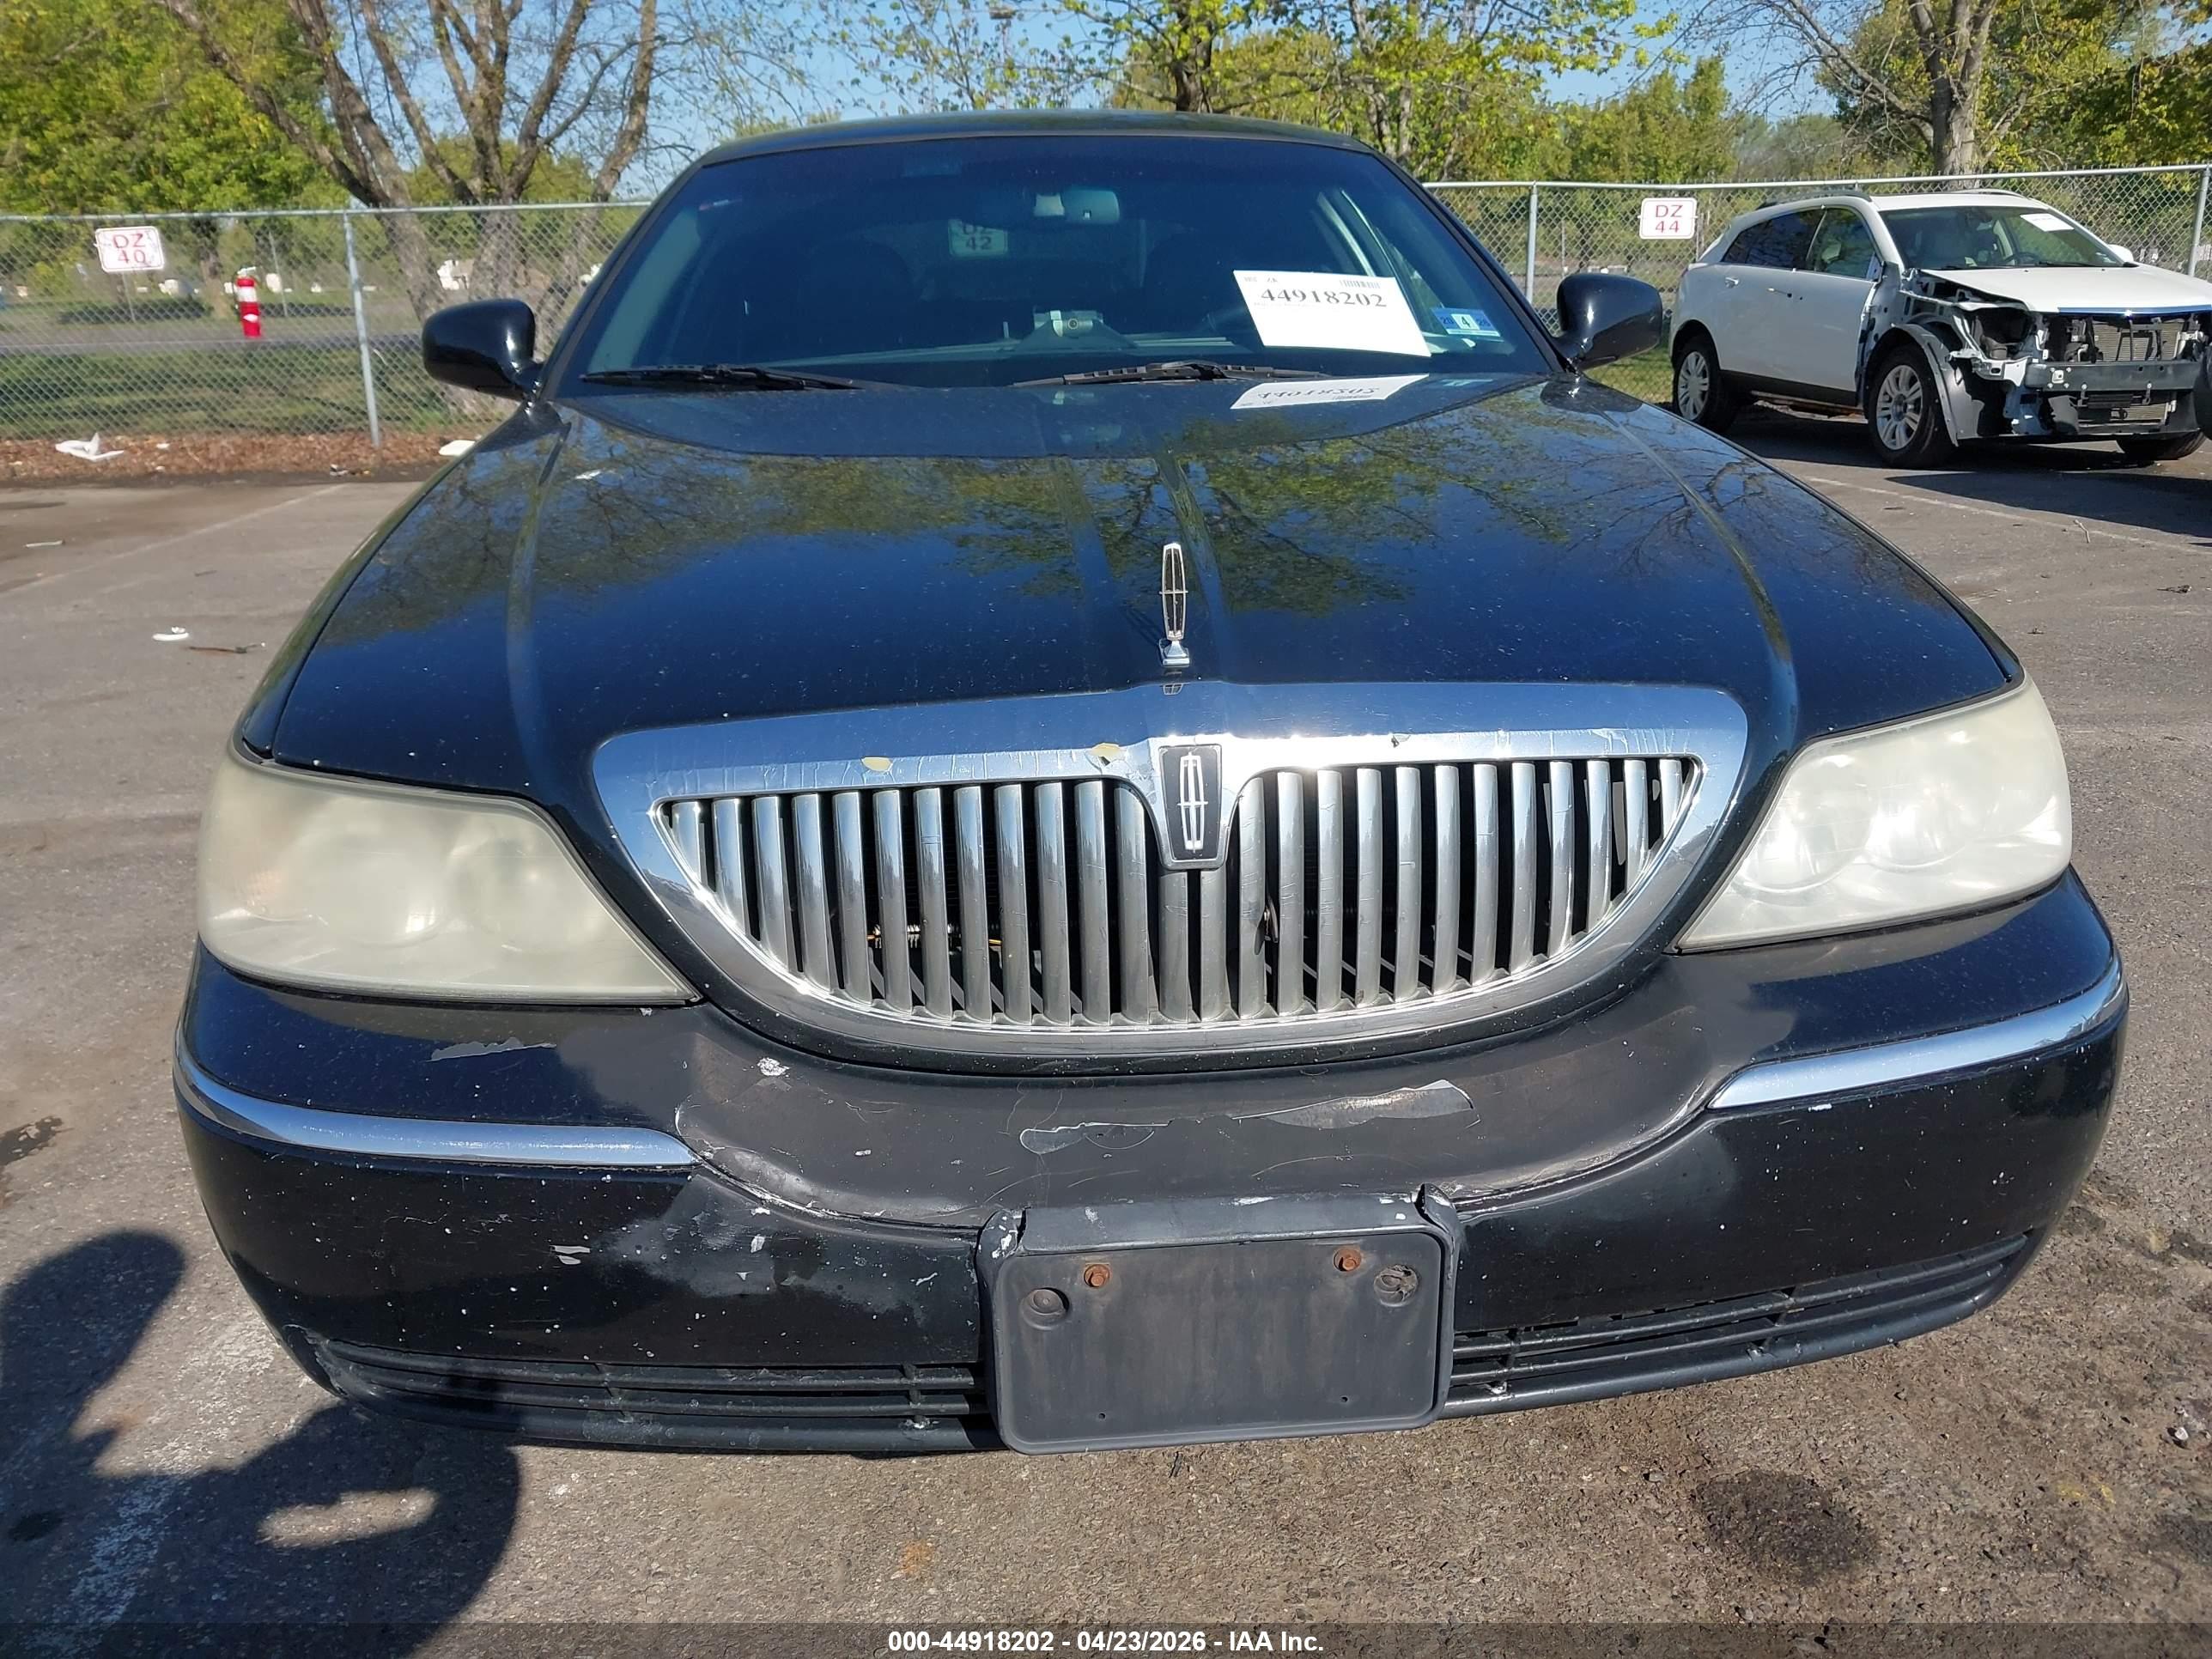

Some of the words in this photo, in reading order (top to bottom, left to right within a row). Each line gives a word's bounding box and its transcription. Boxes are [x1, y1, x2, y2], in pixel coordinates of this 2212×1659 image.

[1655, 204, 1683, 218] DZ
[1655, 220, 1680, 233] 44
[112, 233, 146, 249] DZ
[966, 236, 992, 251] 42
[1261, 288, 1387, 307] 44918202
[1461, 316, 1471, 328] 4
